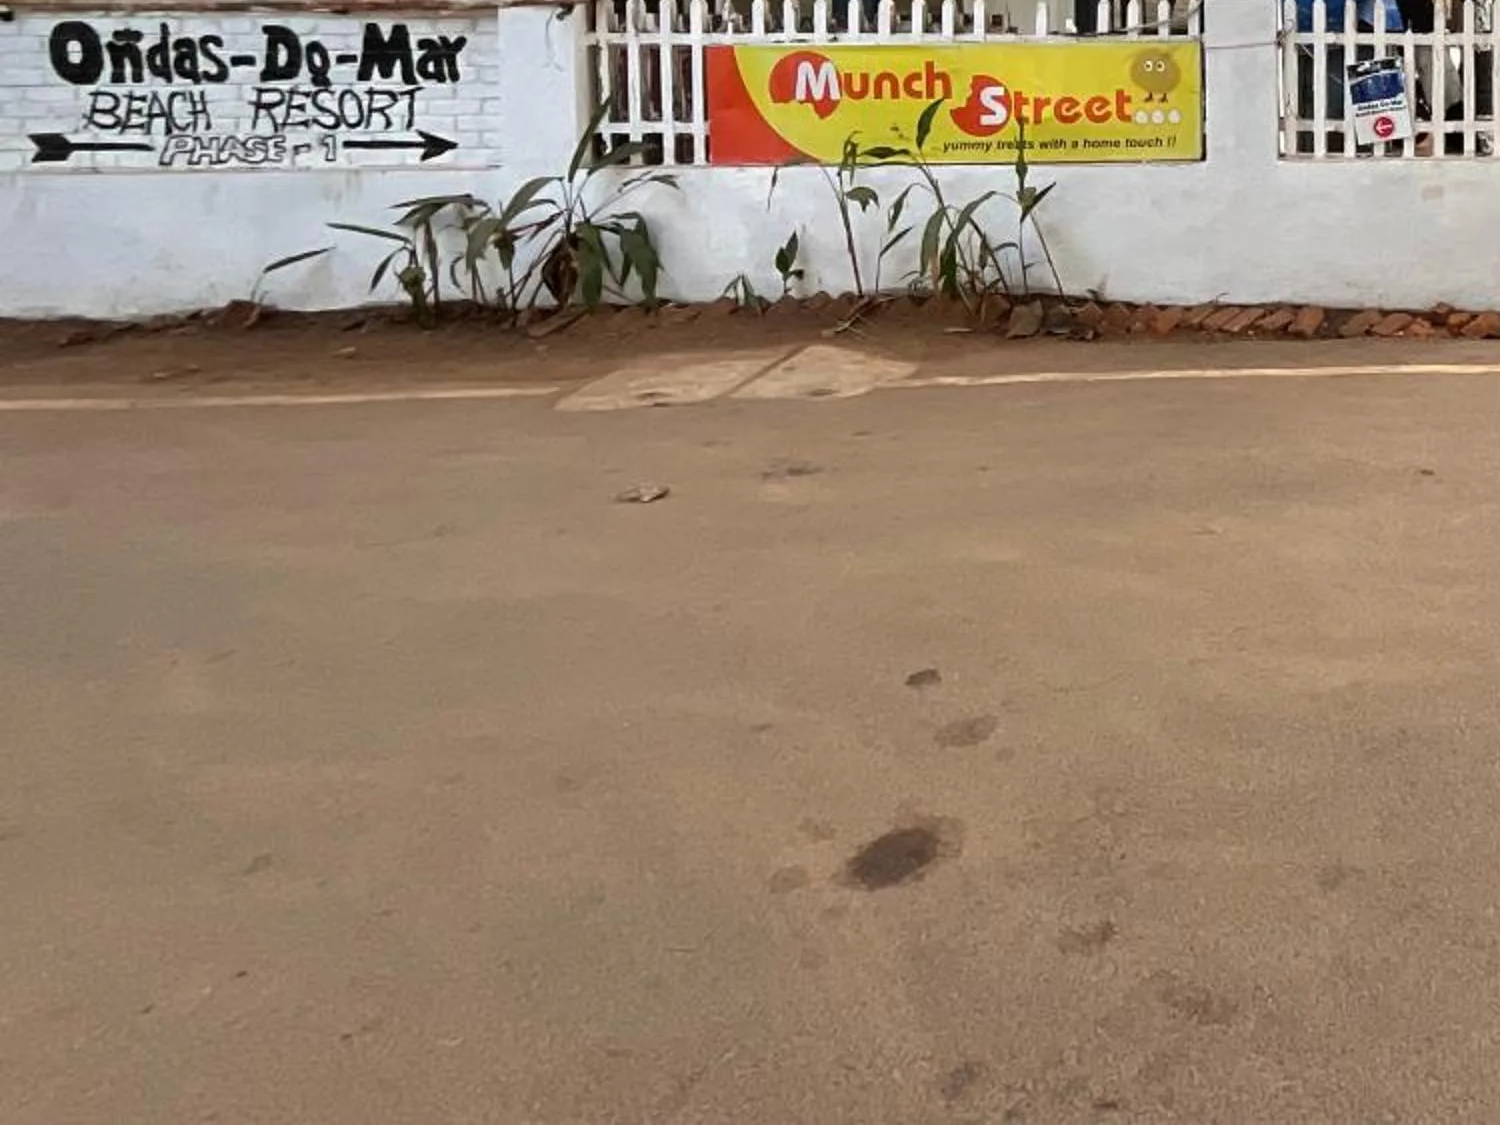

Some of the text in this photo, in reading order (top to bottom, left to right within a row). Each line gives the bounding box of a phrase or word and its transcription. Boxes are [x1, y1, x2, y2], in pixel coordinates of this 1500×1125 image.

[795, 60, 953, 102] Munch
[84, 86, 425, 135] BEACH RESORT
[943, 139, 993, 153] yummy
[1039, 137, 1068, 150] with
[1071, 139, 1079, 149] a
[1083, 137, 1122, 149] home
[1125, 136, 1163, 148] touch
